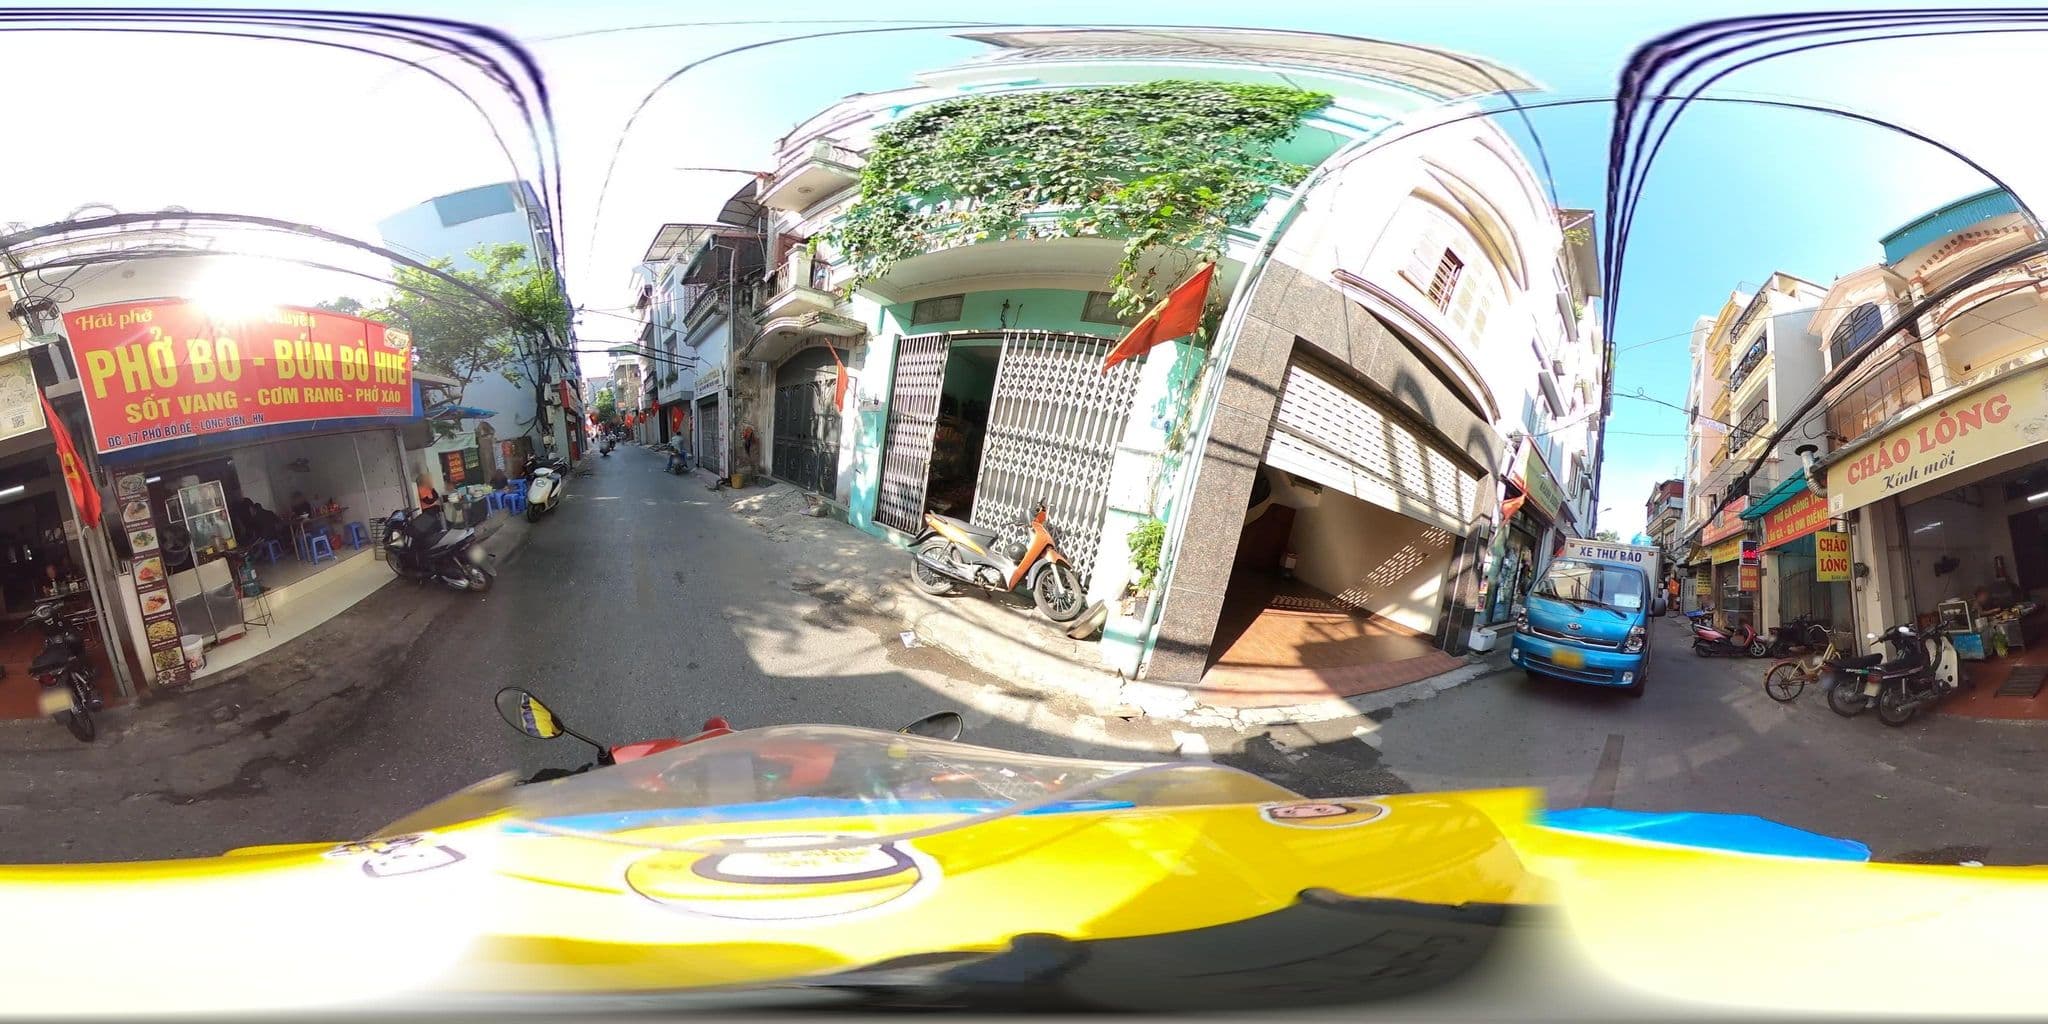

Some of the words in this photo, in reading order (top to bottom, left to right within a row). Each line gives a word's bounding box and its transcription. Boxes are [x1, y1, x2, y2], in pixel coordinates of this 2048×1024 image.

[85, 326, 178, 399] PHỞ
[186, 327, 242, 384] BÒ
[273, 333, 335, 380] BÚN
[339, 339, 370, 382] BÒ
[374, 347, 407, 385] HUẾ
[125, 393, 172, 424] SỐT
[177, 390, 239, 415] VANG
[257, 386, 299, 406] CƠM
[304, 387, 344, 403] RANG
[355, 384, 379, 402] PHỞ
[200, 417, 224, 430] LONG
[1847, 438, 1911, 485] CHÁO
[1917, 393, 2012, 454] LÒNG
[1880, 465, 1919, 493] Kính
[1923, 449, 1956, 476] mời
[1579, 546, 1593, 557] XE
[1596, 548, 1617, 560] THƯ
[1819, 535, 1847, 551] CHÁO
[1820, 554, 1848, 572] LÒNG
